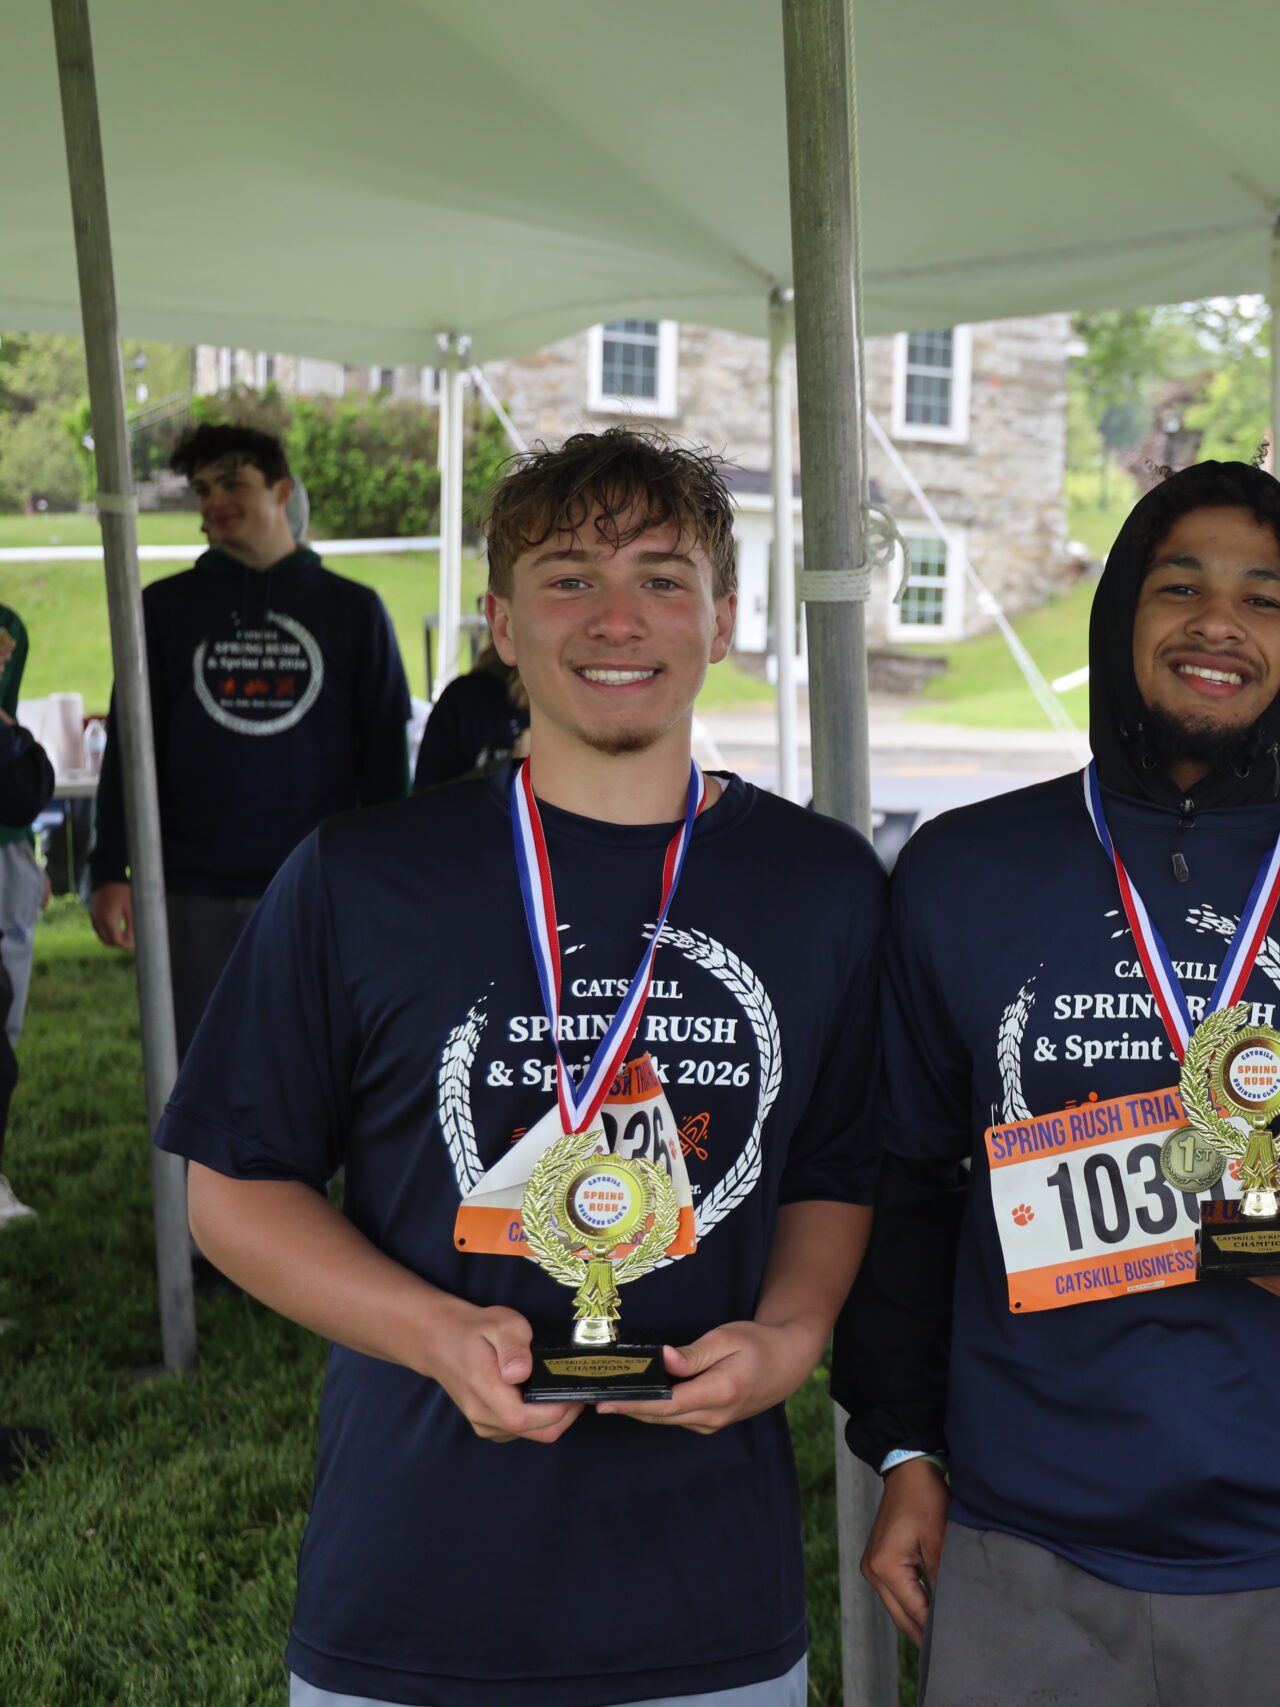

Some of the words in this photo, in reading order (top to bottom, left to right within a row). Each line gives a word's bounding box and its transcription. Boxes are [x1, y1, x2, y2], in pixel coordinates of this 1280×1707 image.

[1114, 960, 1218, 982] CAKILL
[572, 979, 683, 999] CATSILL
[1186, 996, 1276, 1029] RH
[509, 1015, 637, 1043] SPRIN
[645, 1016, 738, 1044] RUSH
[1033, 1036, 1058, 1062] &
[1065, 1032, 1163, 1067] Sprint
[1241, 1050, 1273, 1060] CATSKILL
[486, 1060, 514, 1087] &
[678, 1059, 750, 1087] 2026
[1237, 1065, 1278, 1074] SPRING
[1233, 1078, 1261, 1099] BUSINESS
[1244, 1077, 1273, 1085] RUSH
[991, 1117, 1066, 1160] SPRING
[1068, 1107, 1123, 1143] RUSH
[1126, 1091, 1189, 1130] TRIAT
[588, 1176, 621, 1187] CATSKILL
[583, 1191, 624, 1201] SPRING
[589, 1203, 619, 1212] RUSH
[1055, 1264, 1123, 1295] CATSKILL
[1124, 1250, 1196, 1282] BUSINESS
